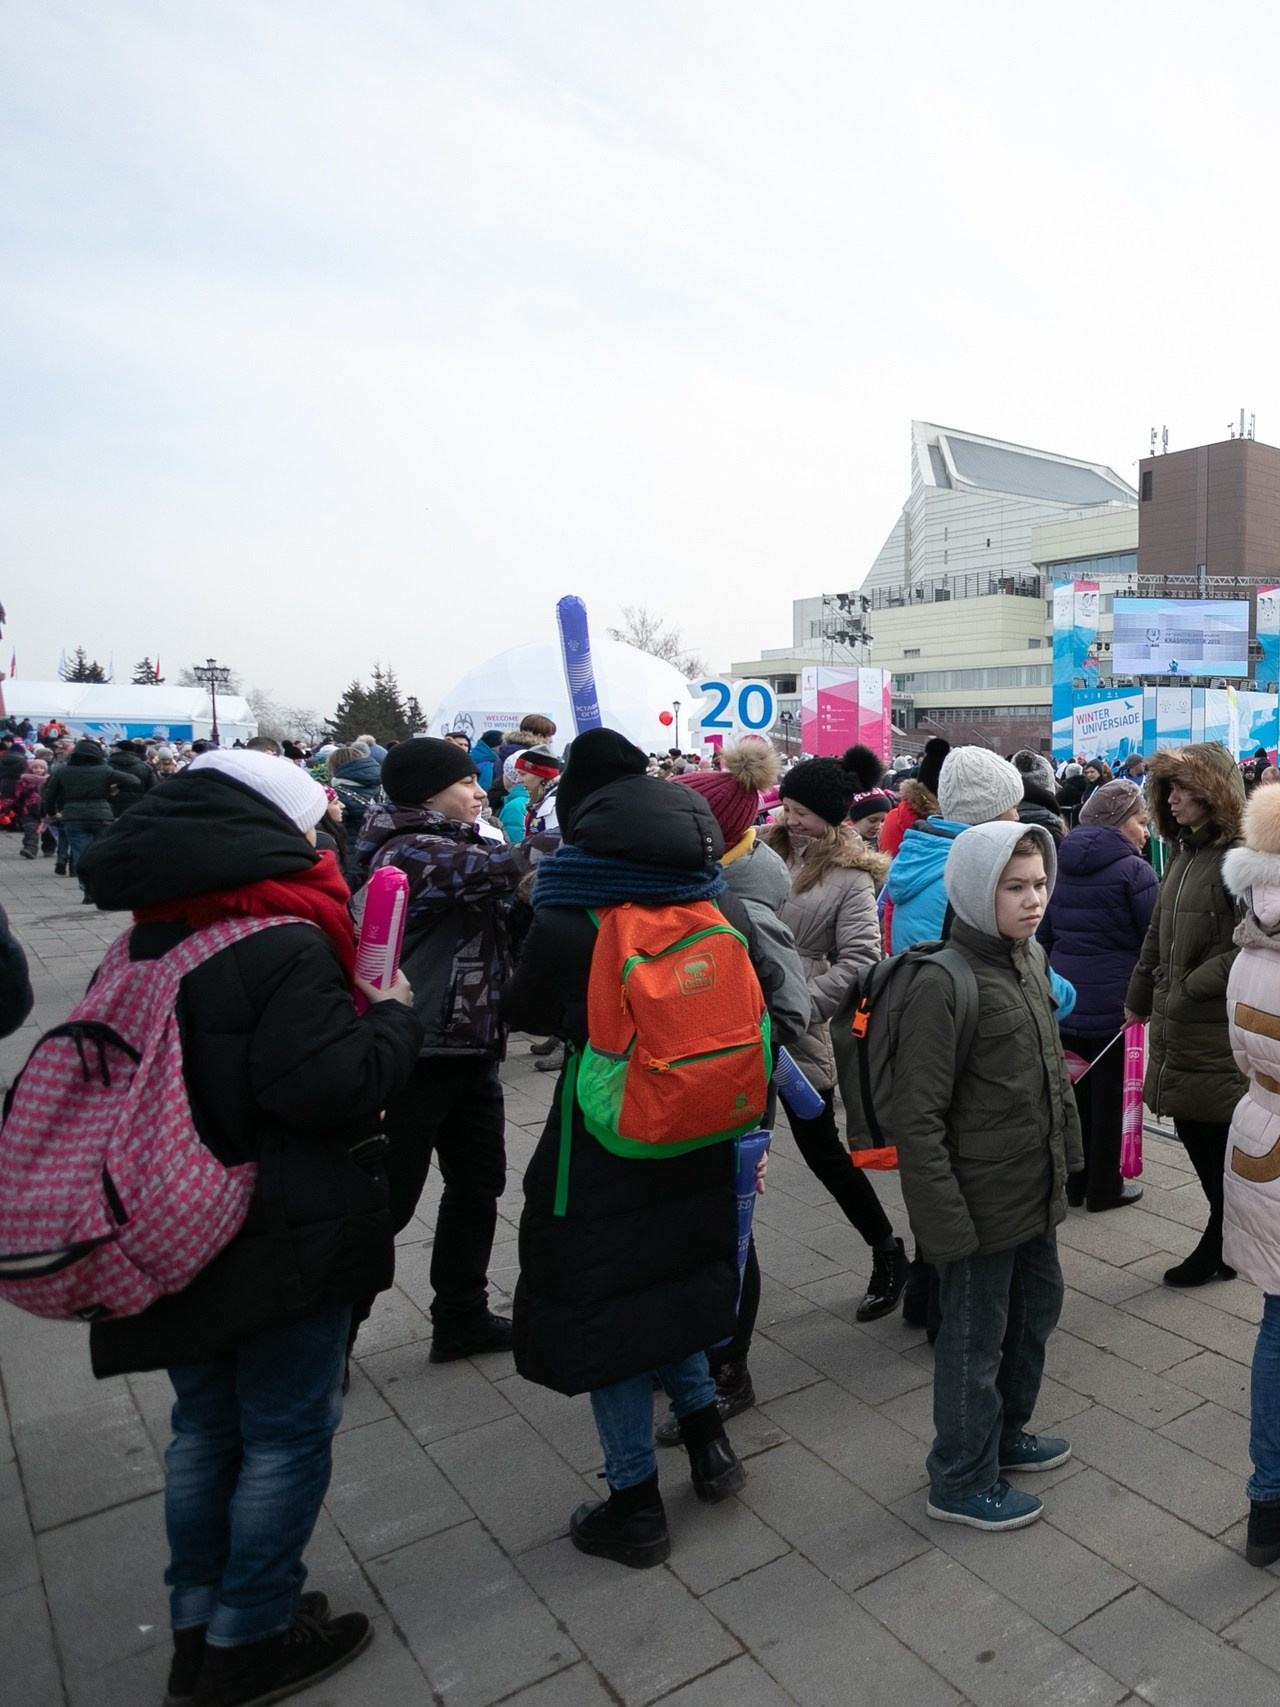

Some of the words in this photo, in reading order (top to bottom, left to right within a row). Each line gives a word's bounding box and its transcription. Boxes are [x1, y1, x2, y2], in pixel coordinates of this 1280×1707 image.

[702, 682, 772, 729] 20
[1076, 708, 1110, 725] WINTER
[1082, 712, 1140, 735] UNIVERSIADE
